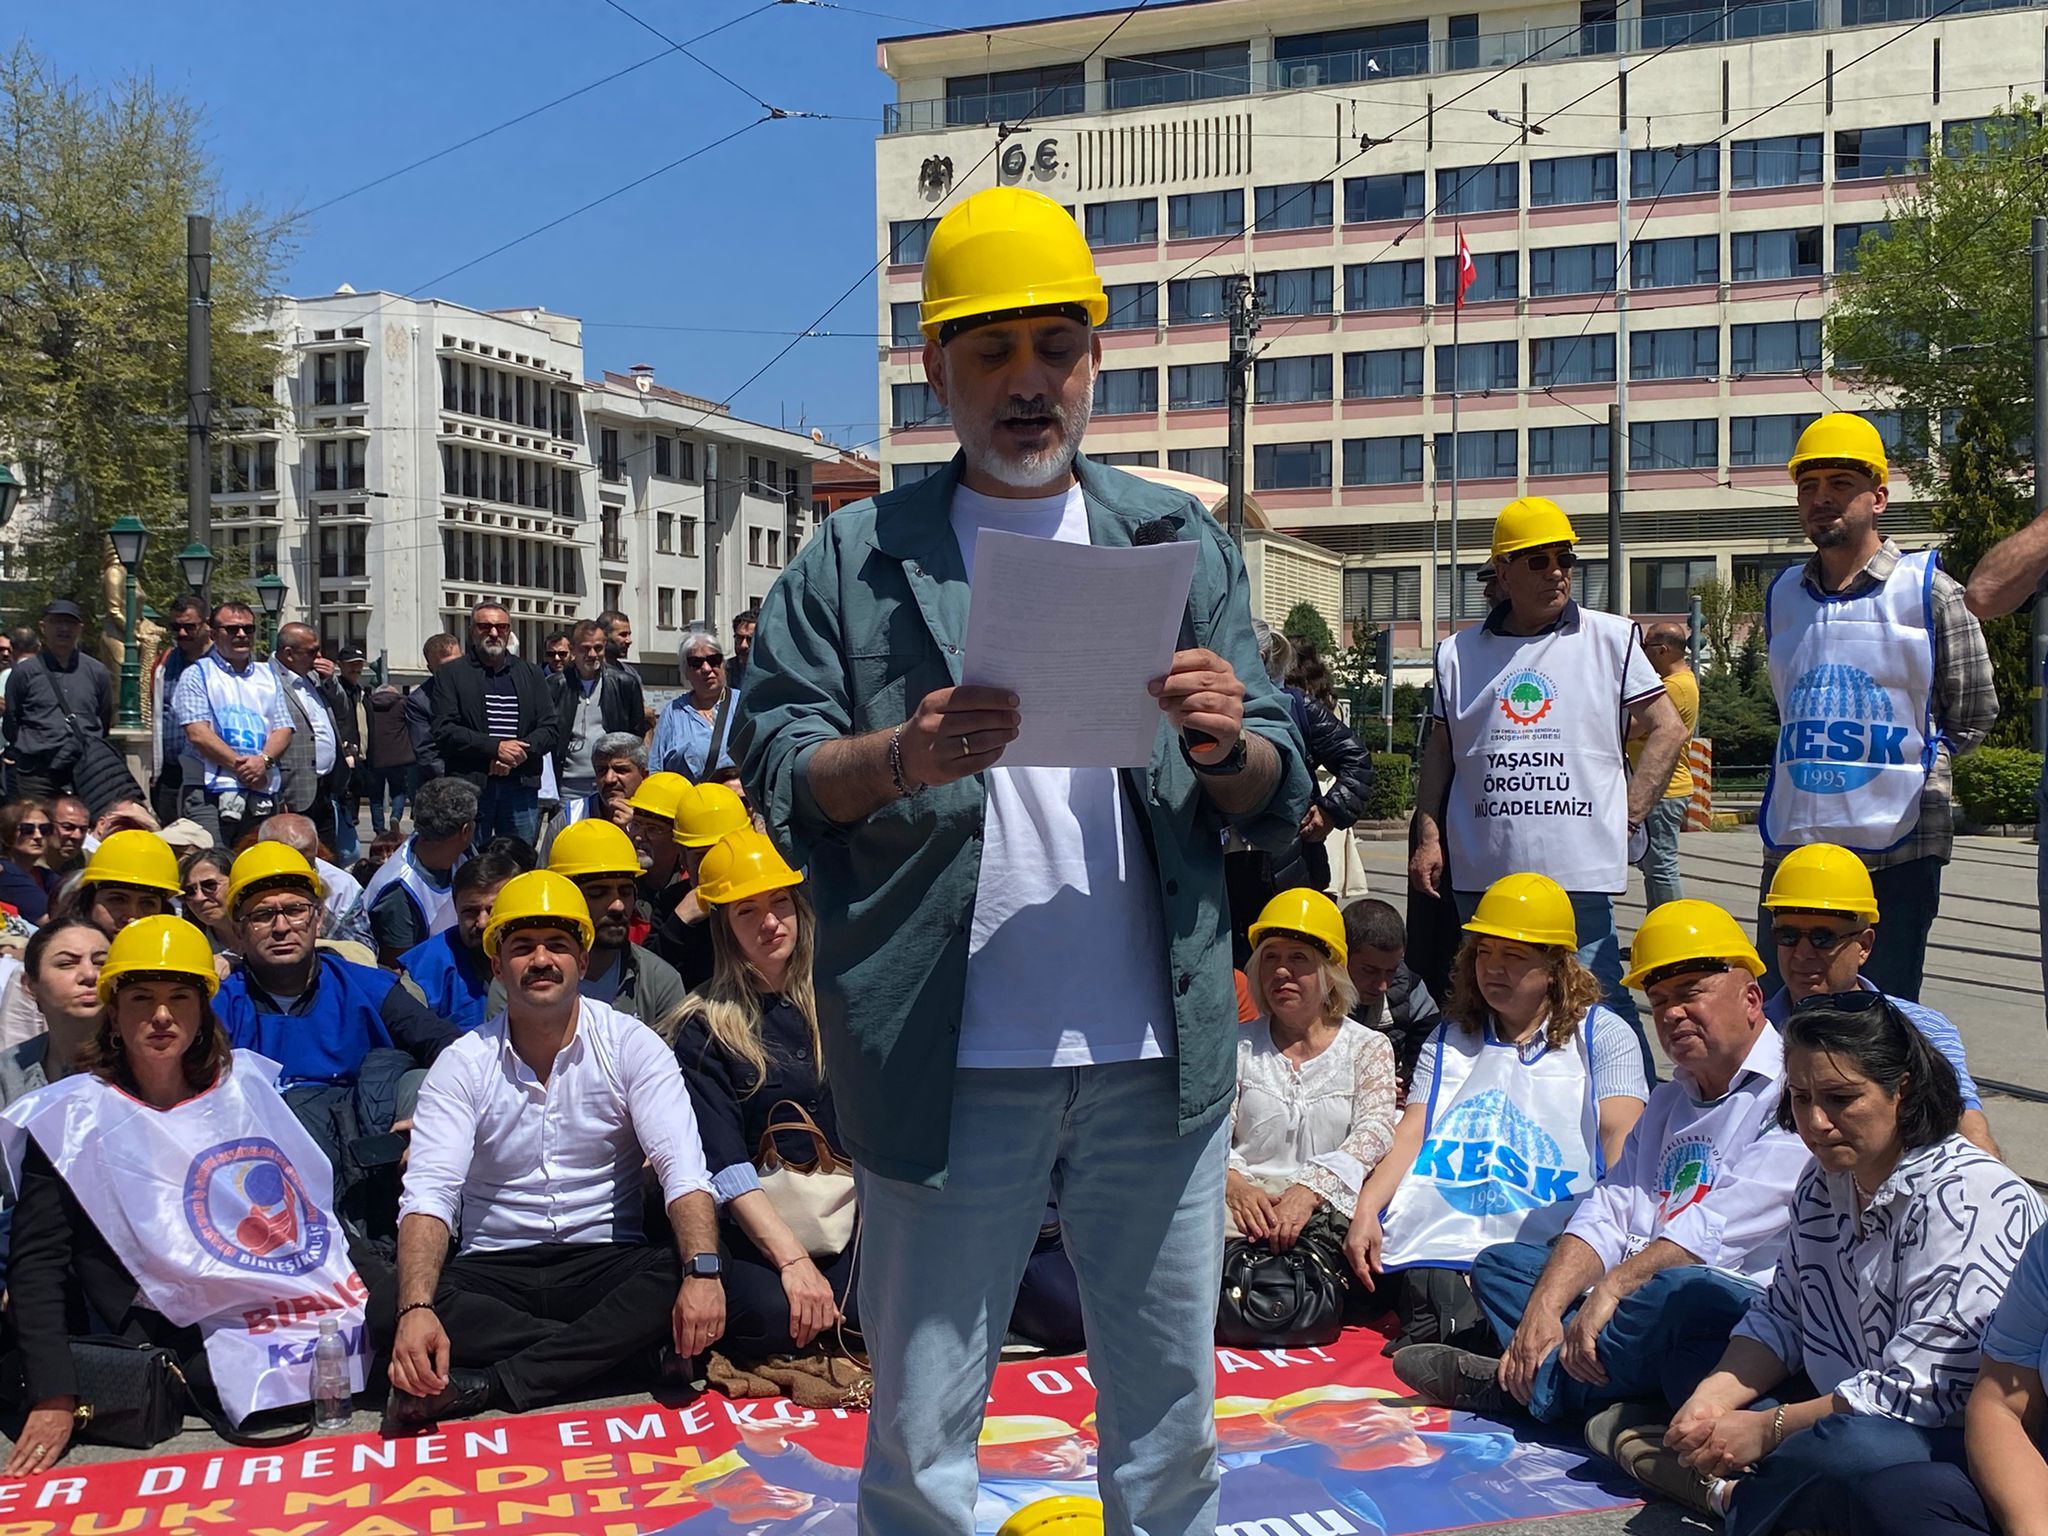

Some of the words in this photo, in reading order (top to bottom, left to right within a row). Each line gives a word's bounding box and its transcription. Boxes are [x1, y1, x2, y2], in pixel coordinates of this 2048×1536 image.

[1780, 720, 1908, 764] KESK
[1487, 752, 1564, 770] YAŞASIN
[1483, 772, 1570, 793] ÖRGÜTLÜ
[1802, 769, 1846, 787] 1995
[1474, 797, 1592, 817] MÜCADELEMİZ!
[1412, 1139, 1578, 1202] KESK
[1469, 1189, 1508, 1209] 1995
[137, 1428, 509, 1497] DİRENEN
[284, 1446, 702, 1515] MADEN
[249, 1480, 698, 1536] YALNIZ
